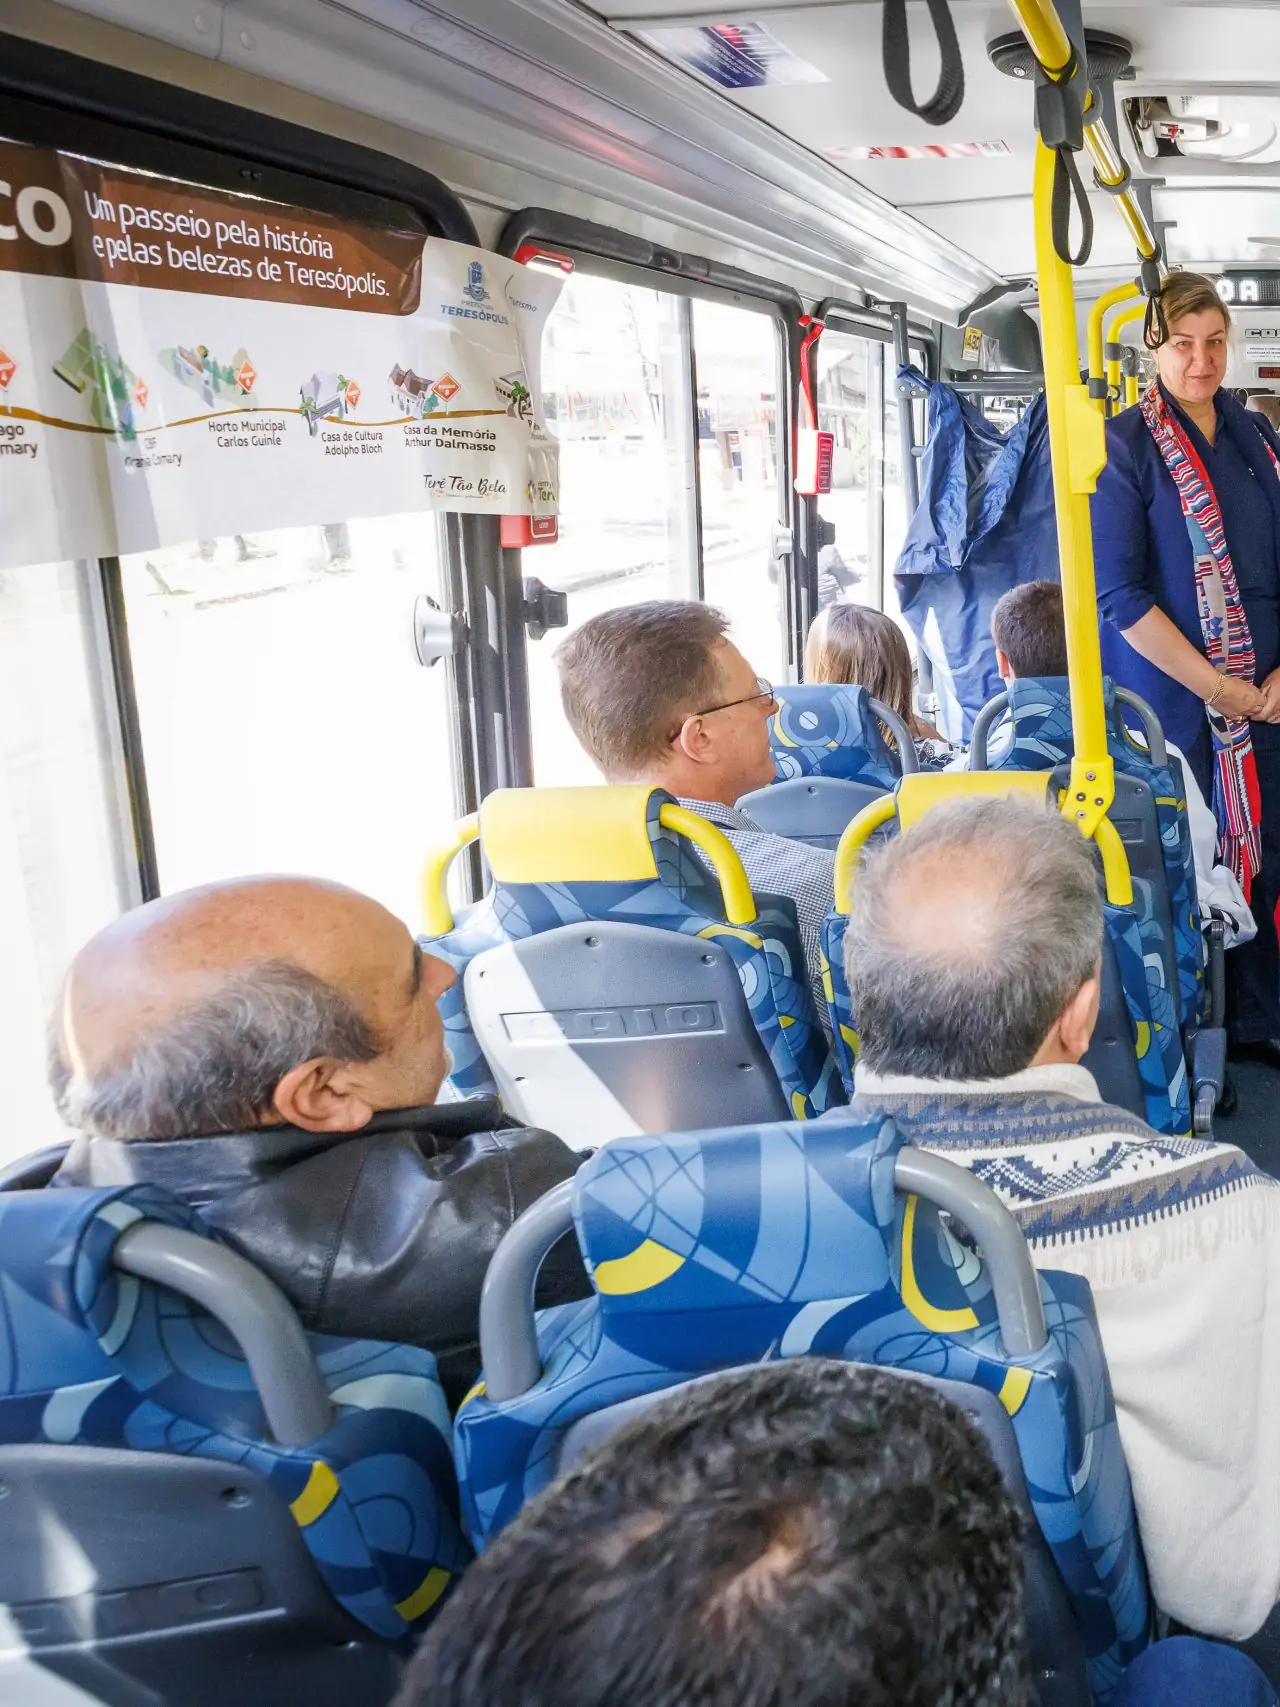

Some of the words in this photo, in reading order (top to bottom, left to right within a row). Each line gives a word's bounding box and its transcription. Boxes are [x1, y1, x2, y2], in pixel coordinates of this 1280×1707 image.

[84, 190, 116, 223] Um
[118, 202, 211, 240] passeio
[215, 220, 260, 249] pela
[263, 224, 333, 259] história
[92, 235, 104, 258] e
[106, 234, 163, 268] pelas
[166, 241, 252, 278] belezas
[257, 256, 282, 282] de
[284, 260, 390, 299] Teresópolis.
[1216, 279, 1259, 301] DA
[440, 304, 509, 326] TERESÓPOLIS
[0, 424, 24, 441] ago
[209, 421, 238, 432] Horto
[241, 418, 286, 435] Municipal
[404, 425, 421, 435] Casa
[424, 424, 438, 435] da
[442, 426, 497, 440] Memória
[217, 436, 249, 448] Carlos
[252, 434, 282, 446] Guinle
[322, 432, 341, 443] Casa
[343, 431, 353, 442] de
[354, 430, 383, 442] Cultura
[405, 437, 433, 447] Arthur
[435, 438, 496, 452] Dalmasso
[0, 442, 38, 459] mary
[325, 444, 359, 458] Adolpho
[361, 443, 383, 455] Bloch
